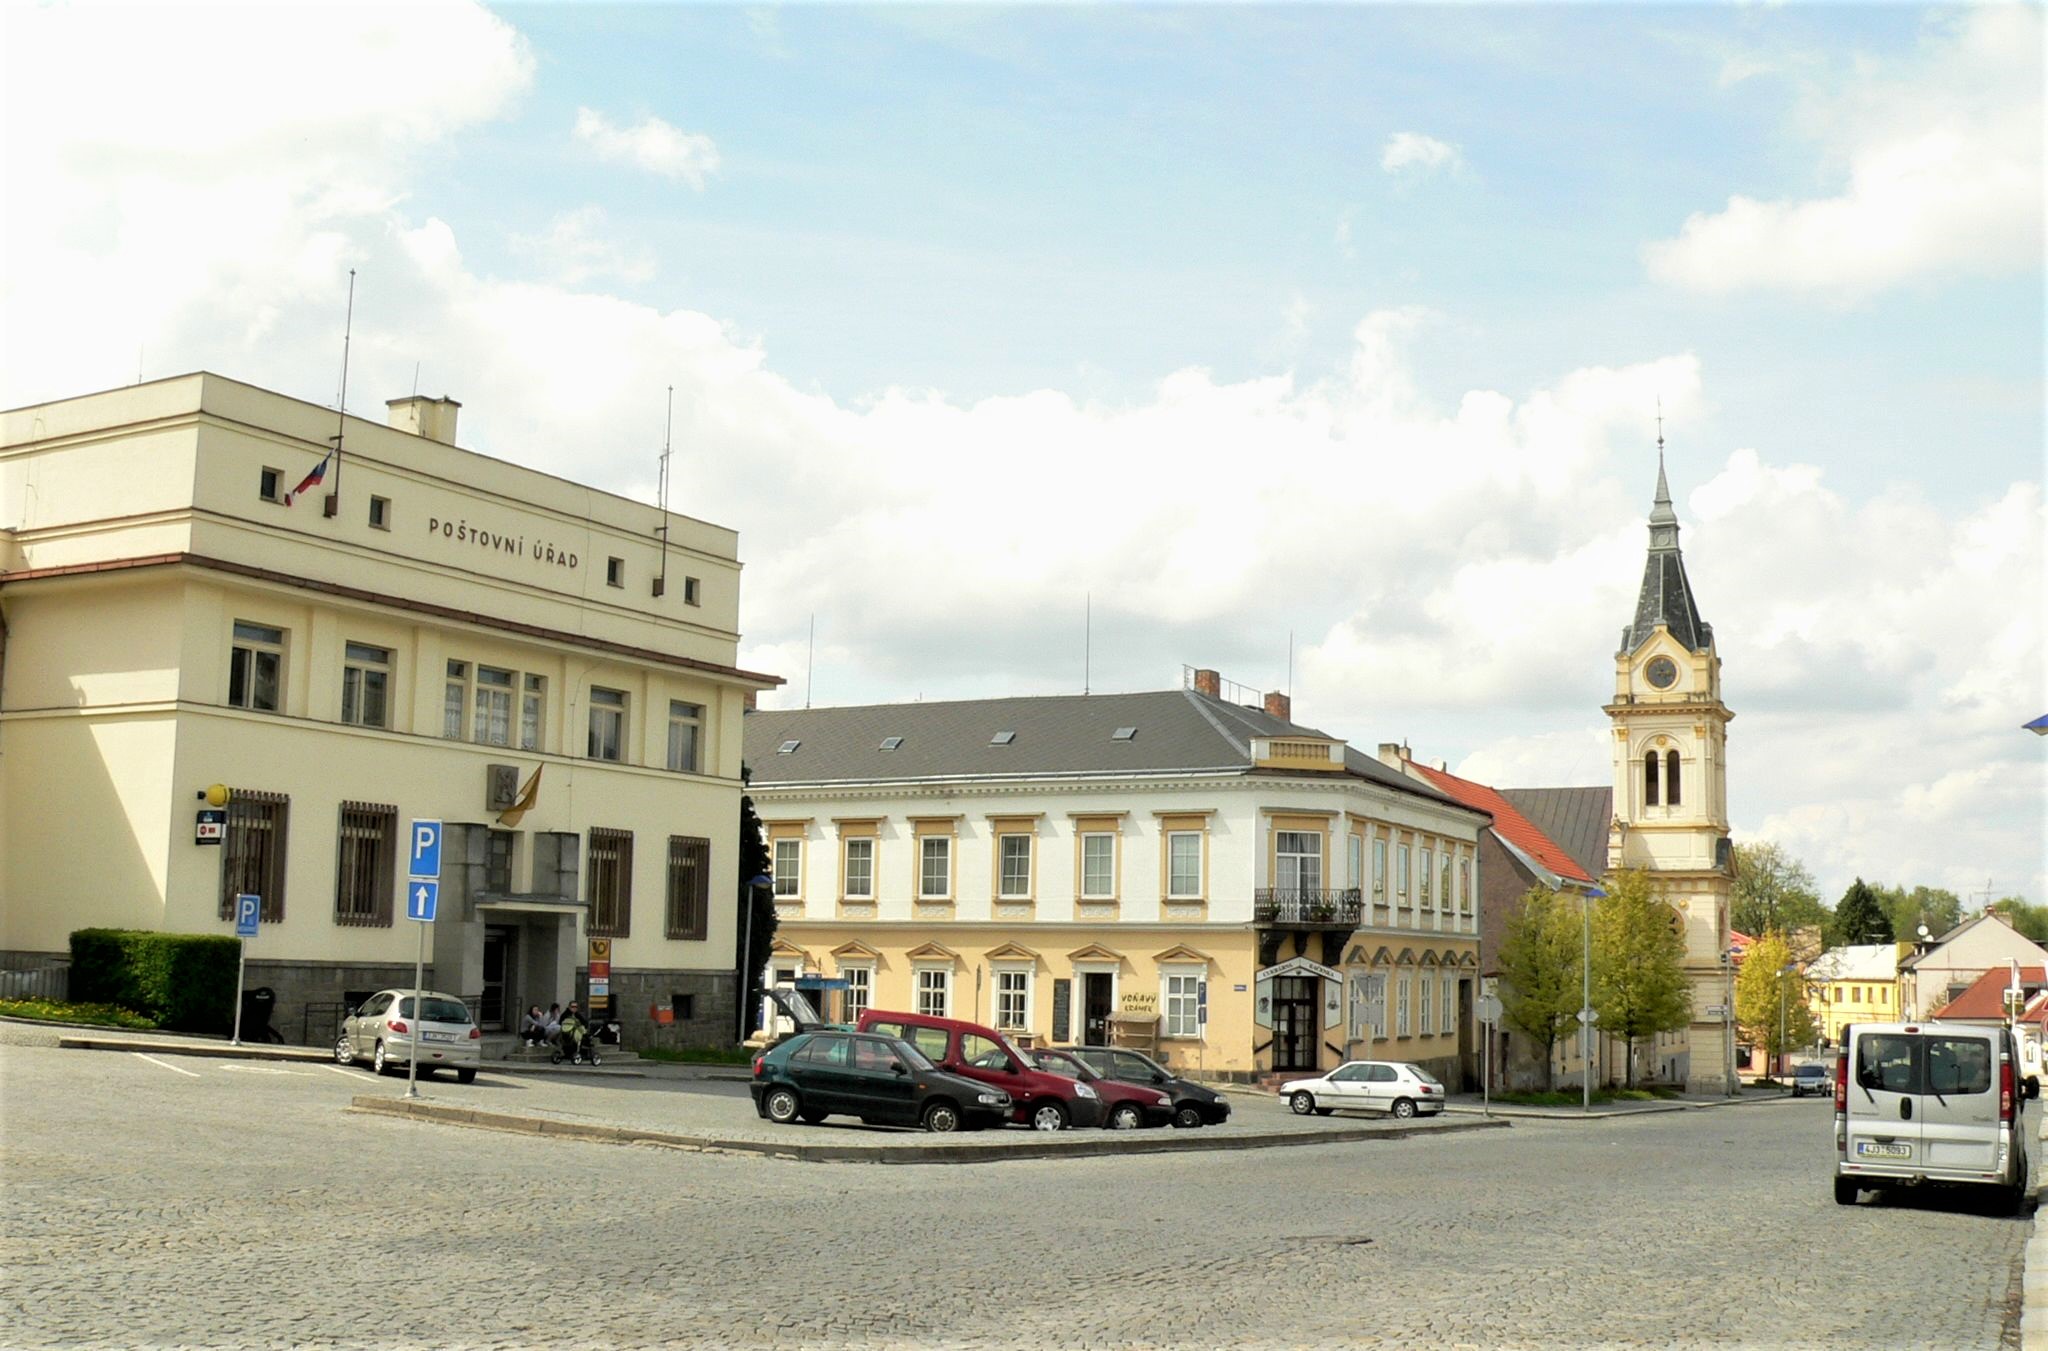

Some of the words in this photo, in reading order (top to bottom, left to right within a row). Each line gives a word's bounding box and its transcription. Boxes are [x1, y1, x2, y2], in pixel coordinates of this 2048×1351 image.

[429, 517, 524, 556] POŠTOVNÍ
[533, 539, 578, 569] ÚŘAD
[416, 827, 435, 859] P
[241, 901, 255, 923] P
